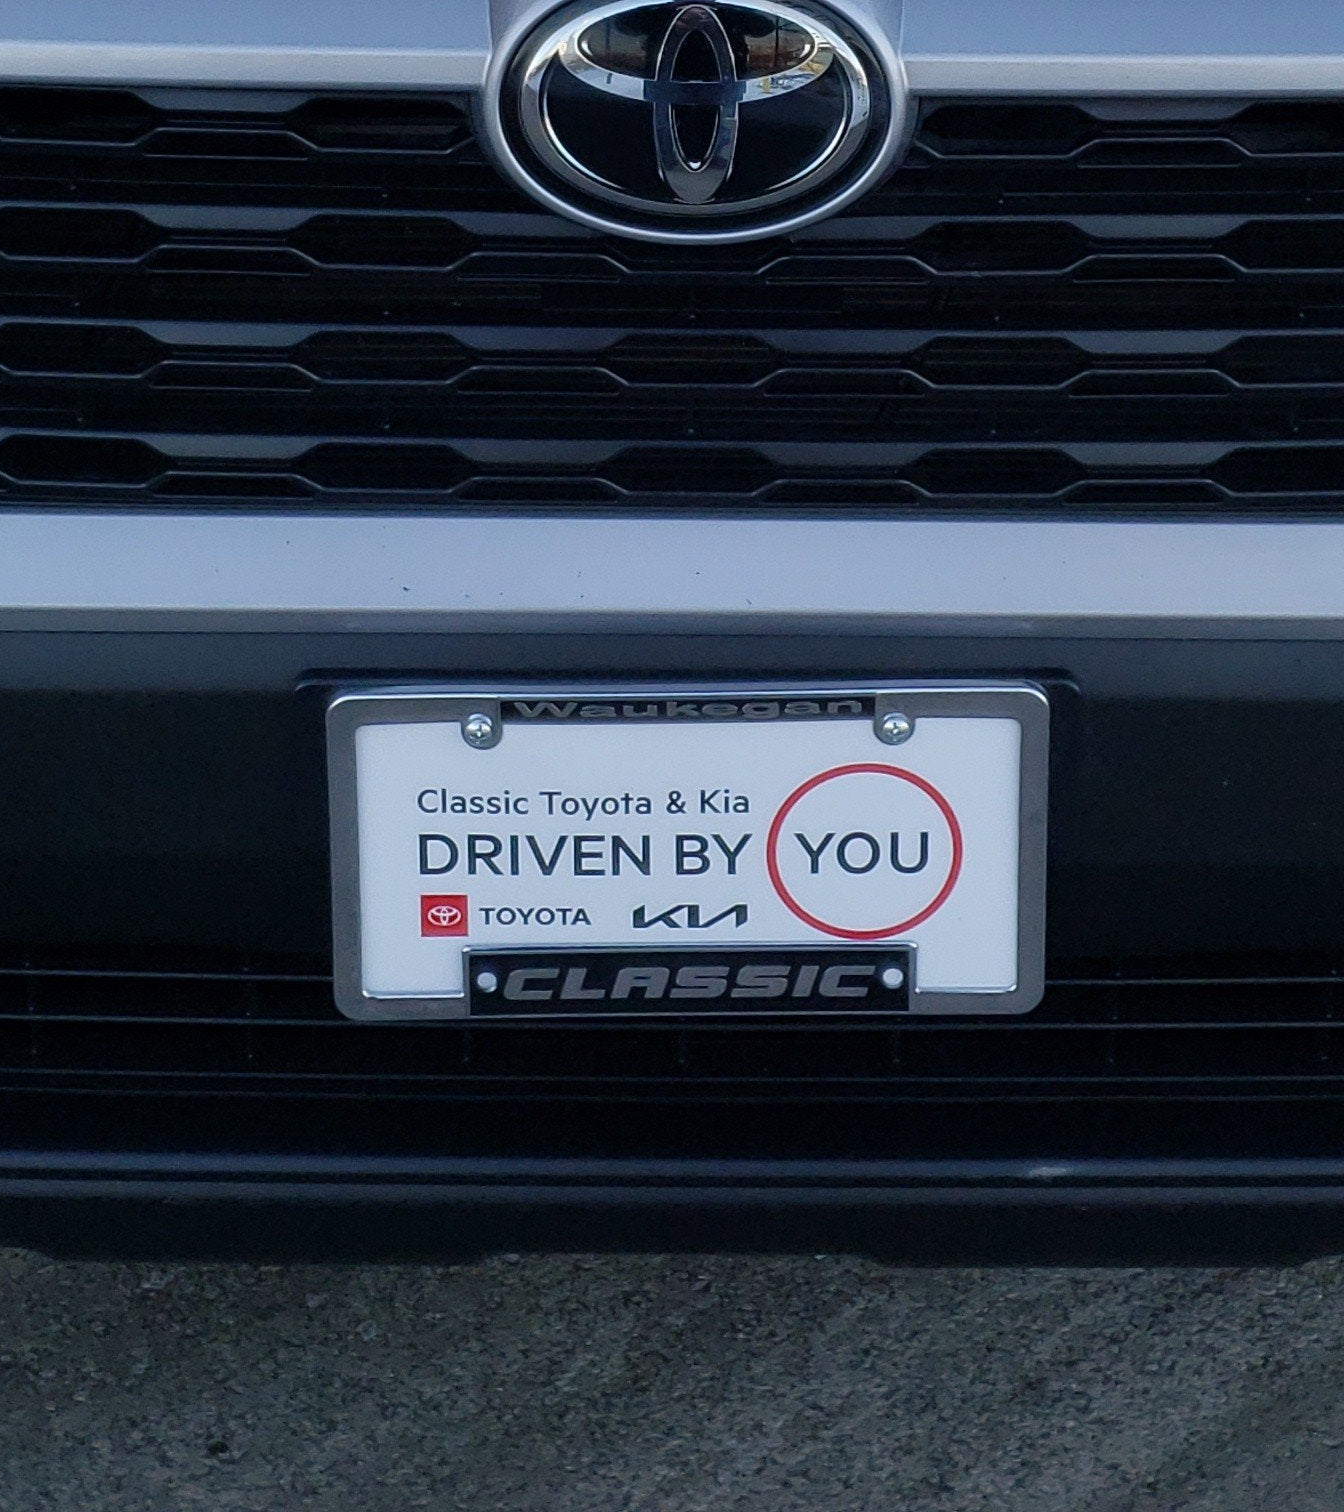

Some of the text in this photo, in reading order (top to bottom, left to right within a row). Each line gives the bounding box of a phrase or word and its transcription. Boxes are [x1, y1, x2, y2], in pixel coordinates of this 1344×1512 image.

[514, 700, 862, 719] Waukegan
[416, 789, 750, 821] Classic Toyota & Kia
[418, 832, 929, 876] DRIVEN BY YOU
[479, 907, 592, 926] TOYOTA
[503, 965, 876, 1001] CLASSIC
